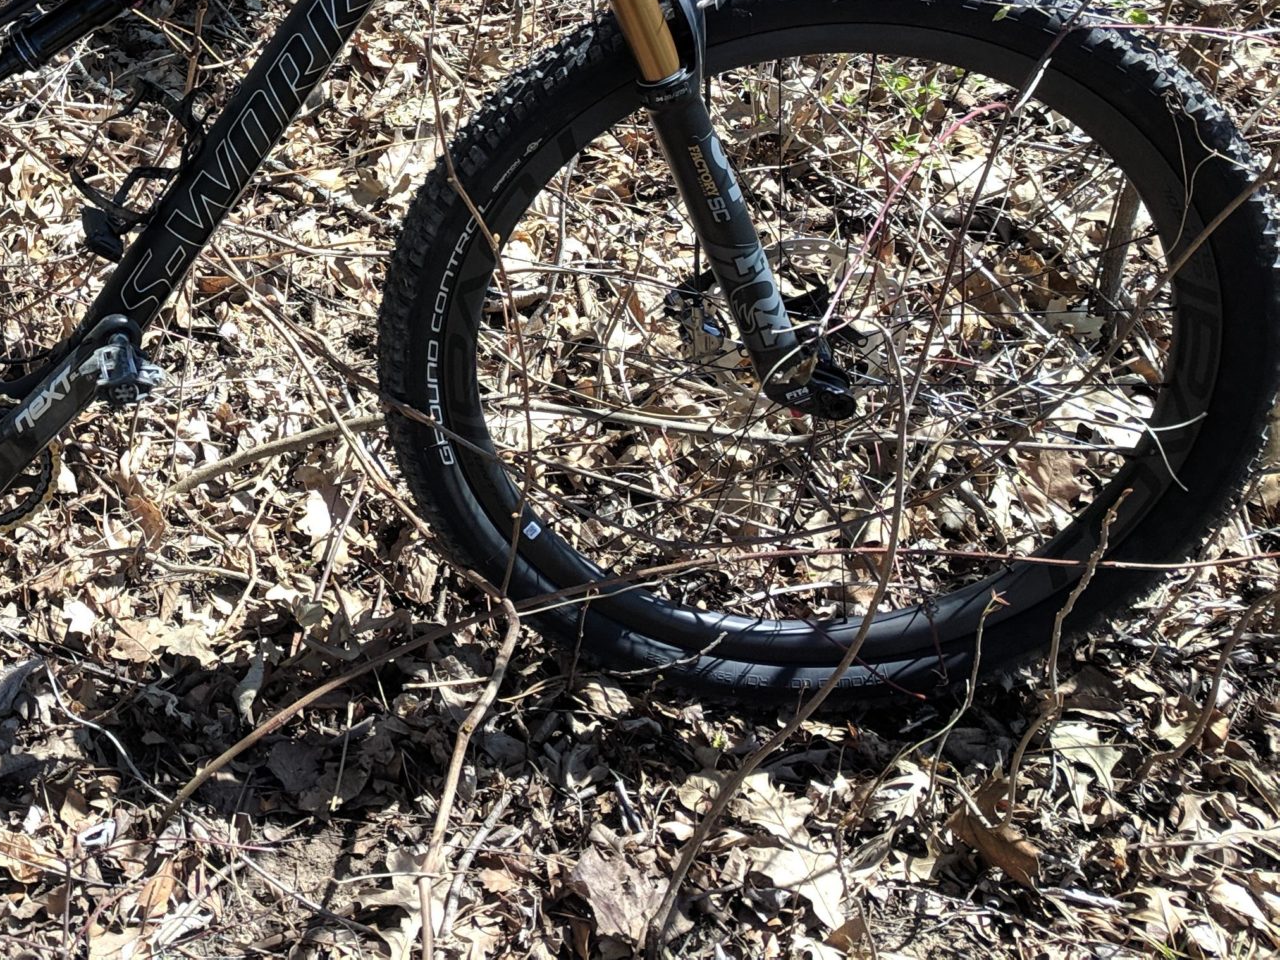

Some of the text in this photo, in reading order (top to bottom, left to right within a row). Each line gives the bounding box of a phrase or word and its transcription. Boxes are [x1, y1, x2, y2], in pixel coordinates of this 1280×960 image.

[687, 144, 720, 196] FACTORY
[708, 196, 731, 223] SC
[426, 198, 493, 466] GROUND CONTROL
[785, 386, 809, 402] FIT4
